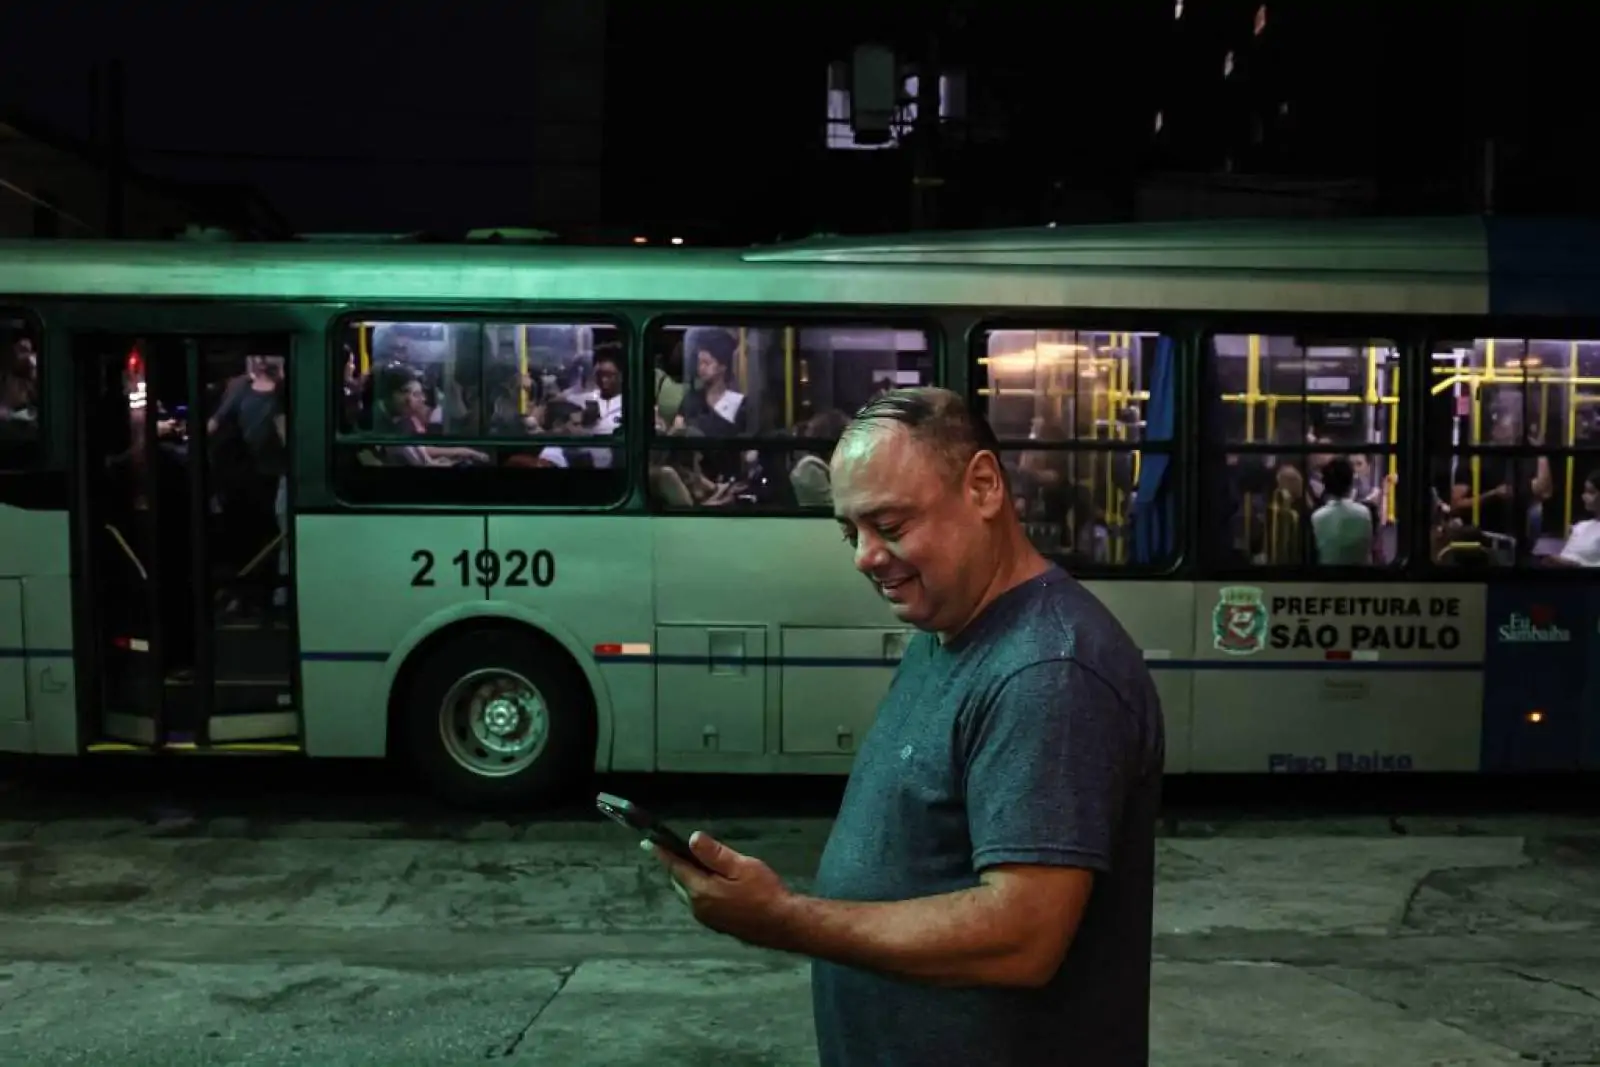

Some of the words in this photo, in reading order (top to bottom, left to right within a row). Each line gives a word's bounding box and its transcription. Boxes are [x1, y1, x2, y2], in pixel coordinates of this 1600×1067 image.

[411, 550, 434, 587] 2
[453, 549, 555, 587] 1920
[1272, 597, 1420, 616] PREFEITURA
[1430, 598, 1460, 616] DE
[1271, 619, 1339, 648] SÃO
[1351, 624, 1460, 649] PAULO
